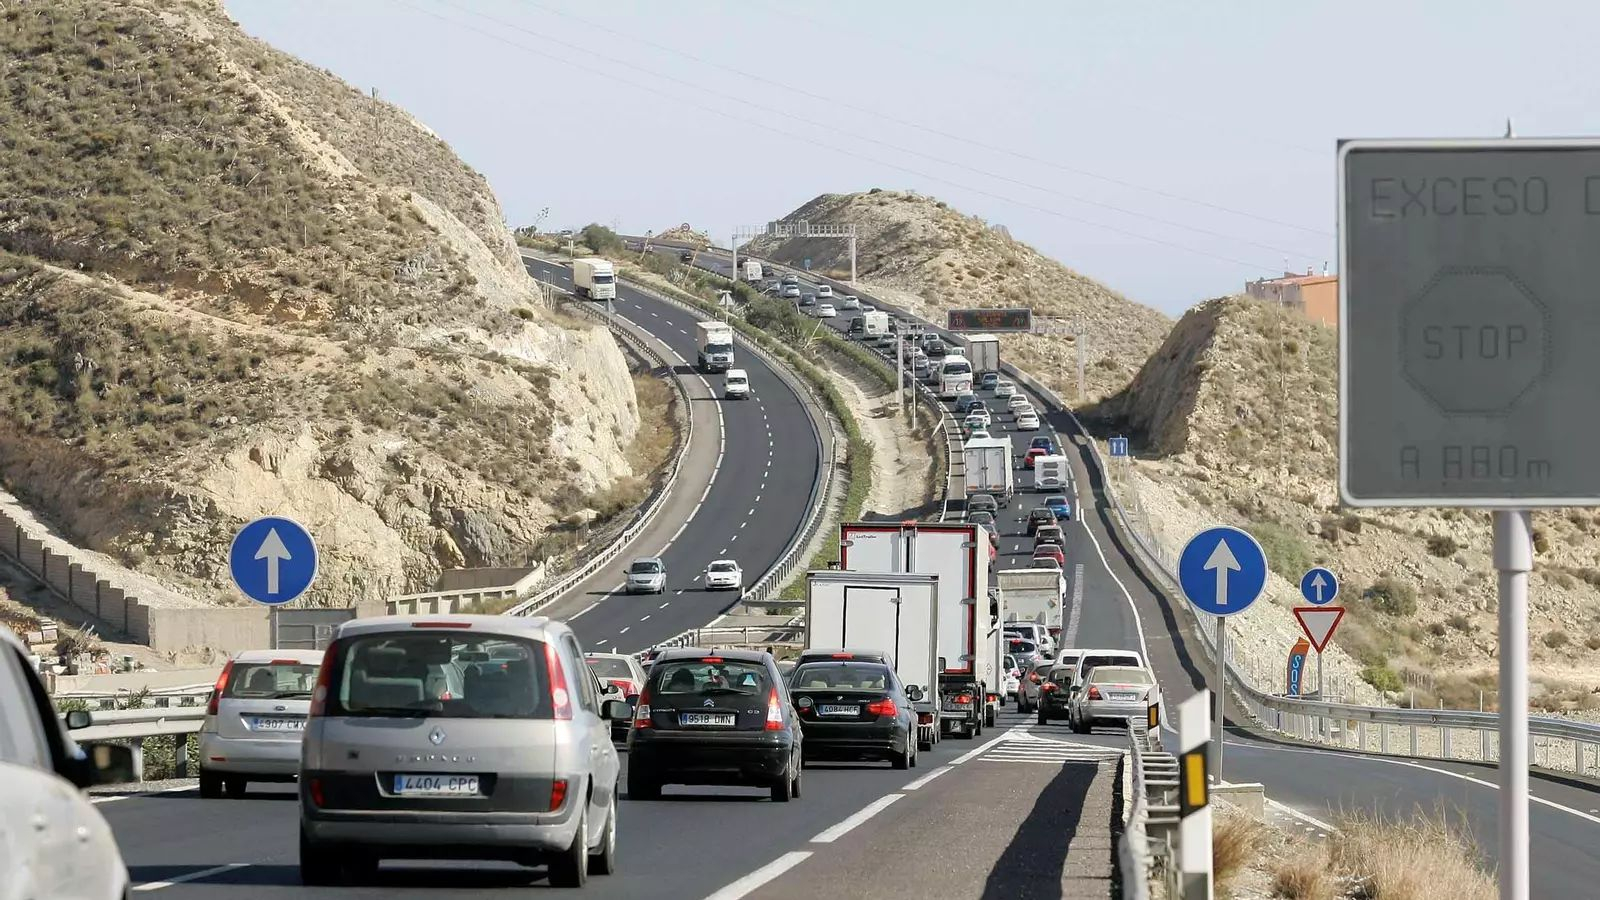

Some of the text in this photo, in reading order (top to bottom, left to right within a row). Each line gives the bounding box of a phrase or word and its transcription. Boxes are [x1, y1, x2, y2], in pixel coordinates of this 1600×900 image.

[1371, 176, 1548, 217] EXCESO
[1423, 325, 1527, 360] STOP
[1401, 446, 1419, 479] A
[1291, 655, 1301, 695] SOS
[687, 714, 710, 724] 9518
[405, 777, 477, 792] 4404 CPC
